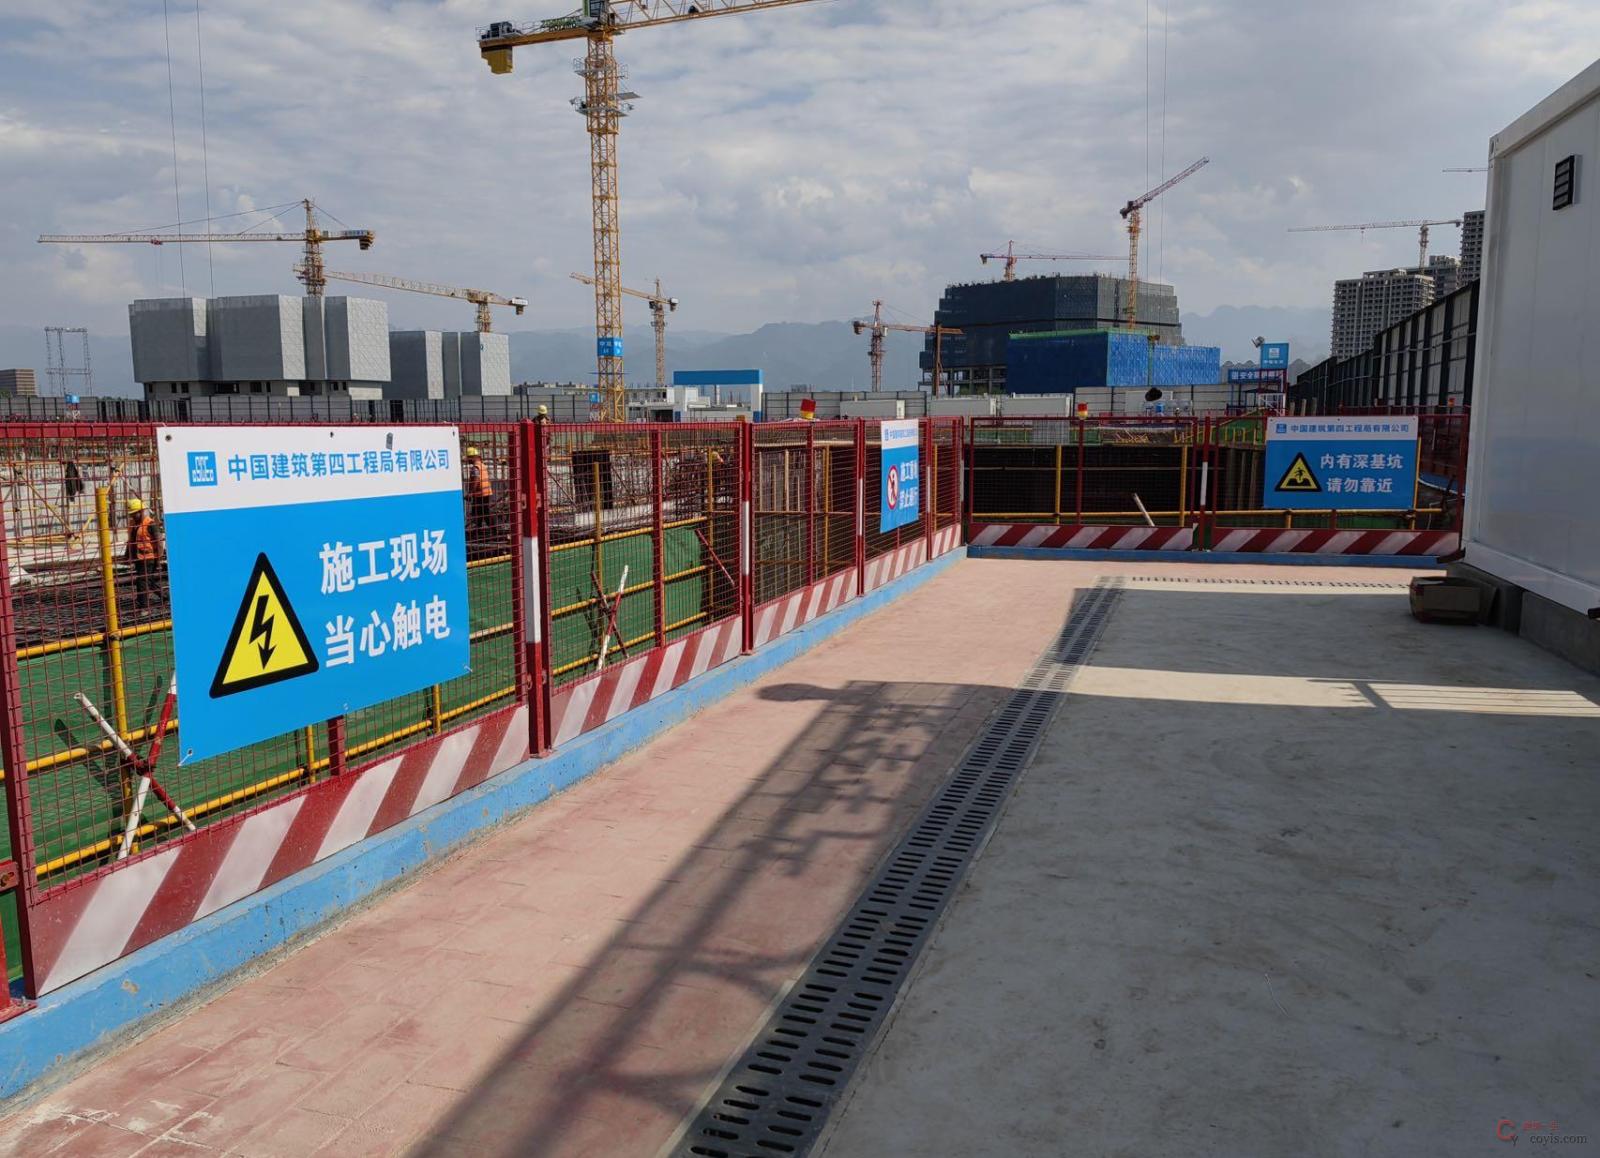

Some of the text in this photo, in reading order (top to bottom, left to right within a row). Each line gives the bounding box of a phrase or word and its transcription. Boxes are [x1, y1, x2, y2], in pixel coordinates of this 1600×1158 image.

[1290, 424, 1409, 433] 中国建筑第四工程局有限公司
[228, 449, 450, 481] 中国建筑第四工程局有限公司
[1320, 453, 1403, 469] 内有深基坑
[1326, 477, 1393, 493] 请勿靠近
[319, 529, 448, 595] 施工现场
[325, 594, 450, 667] 当心触电
